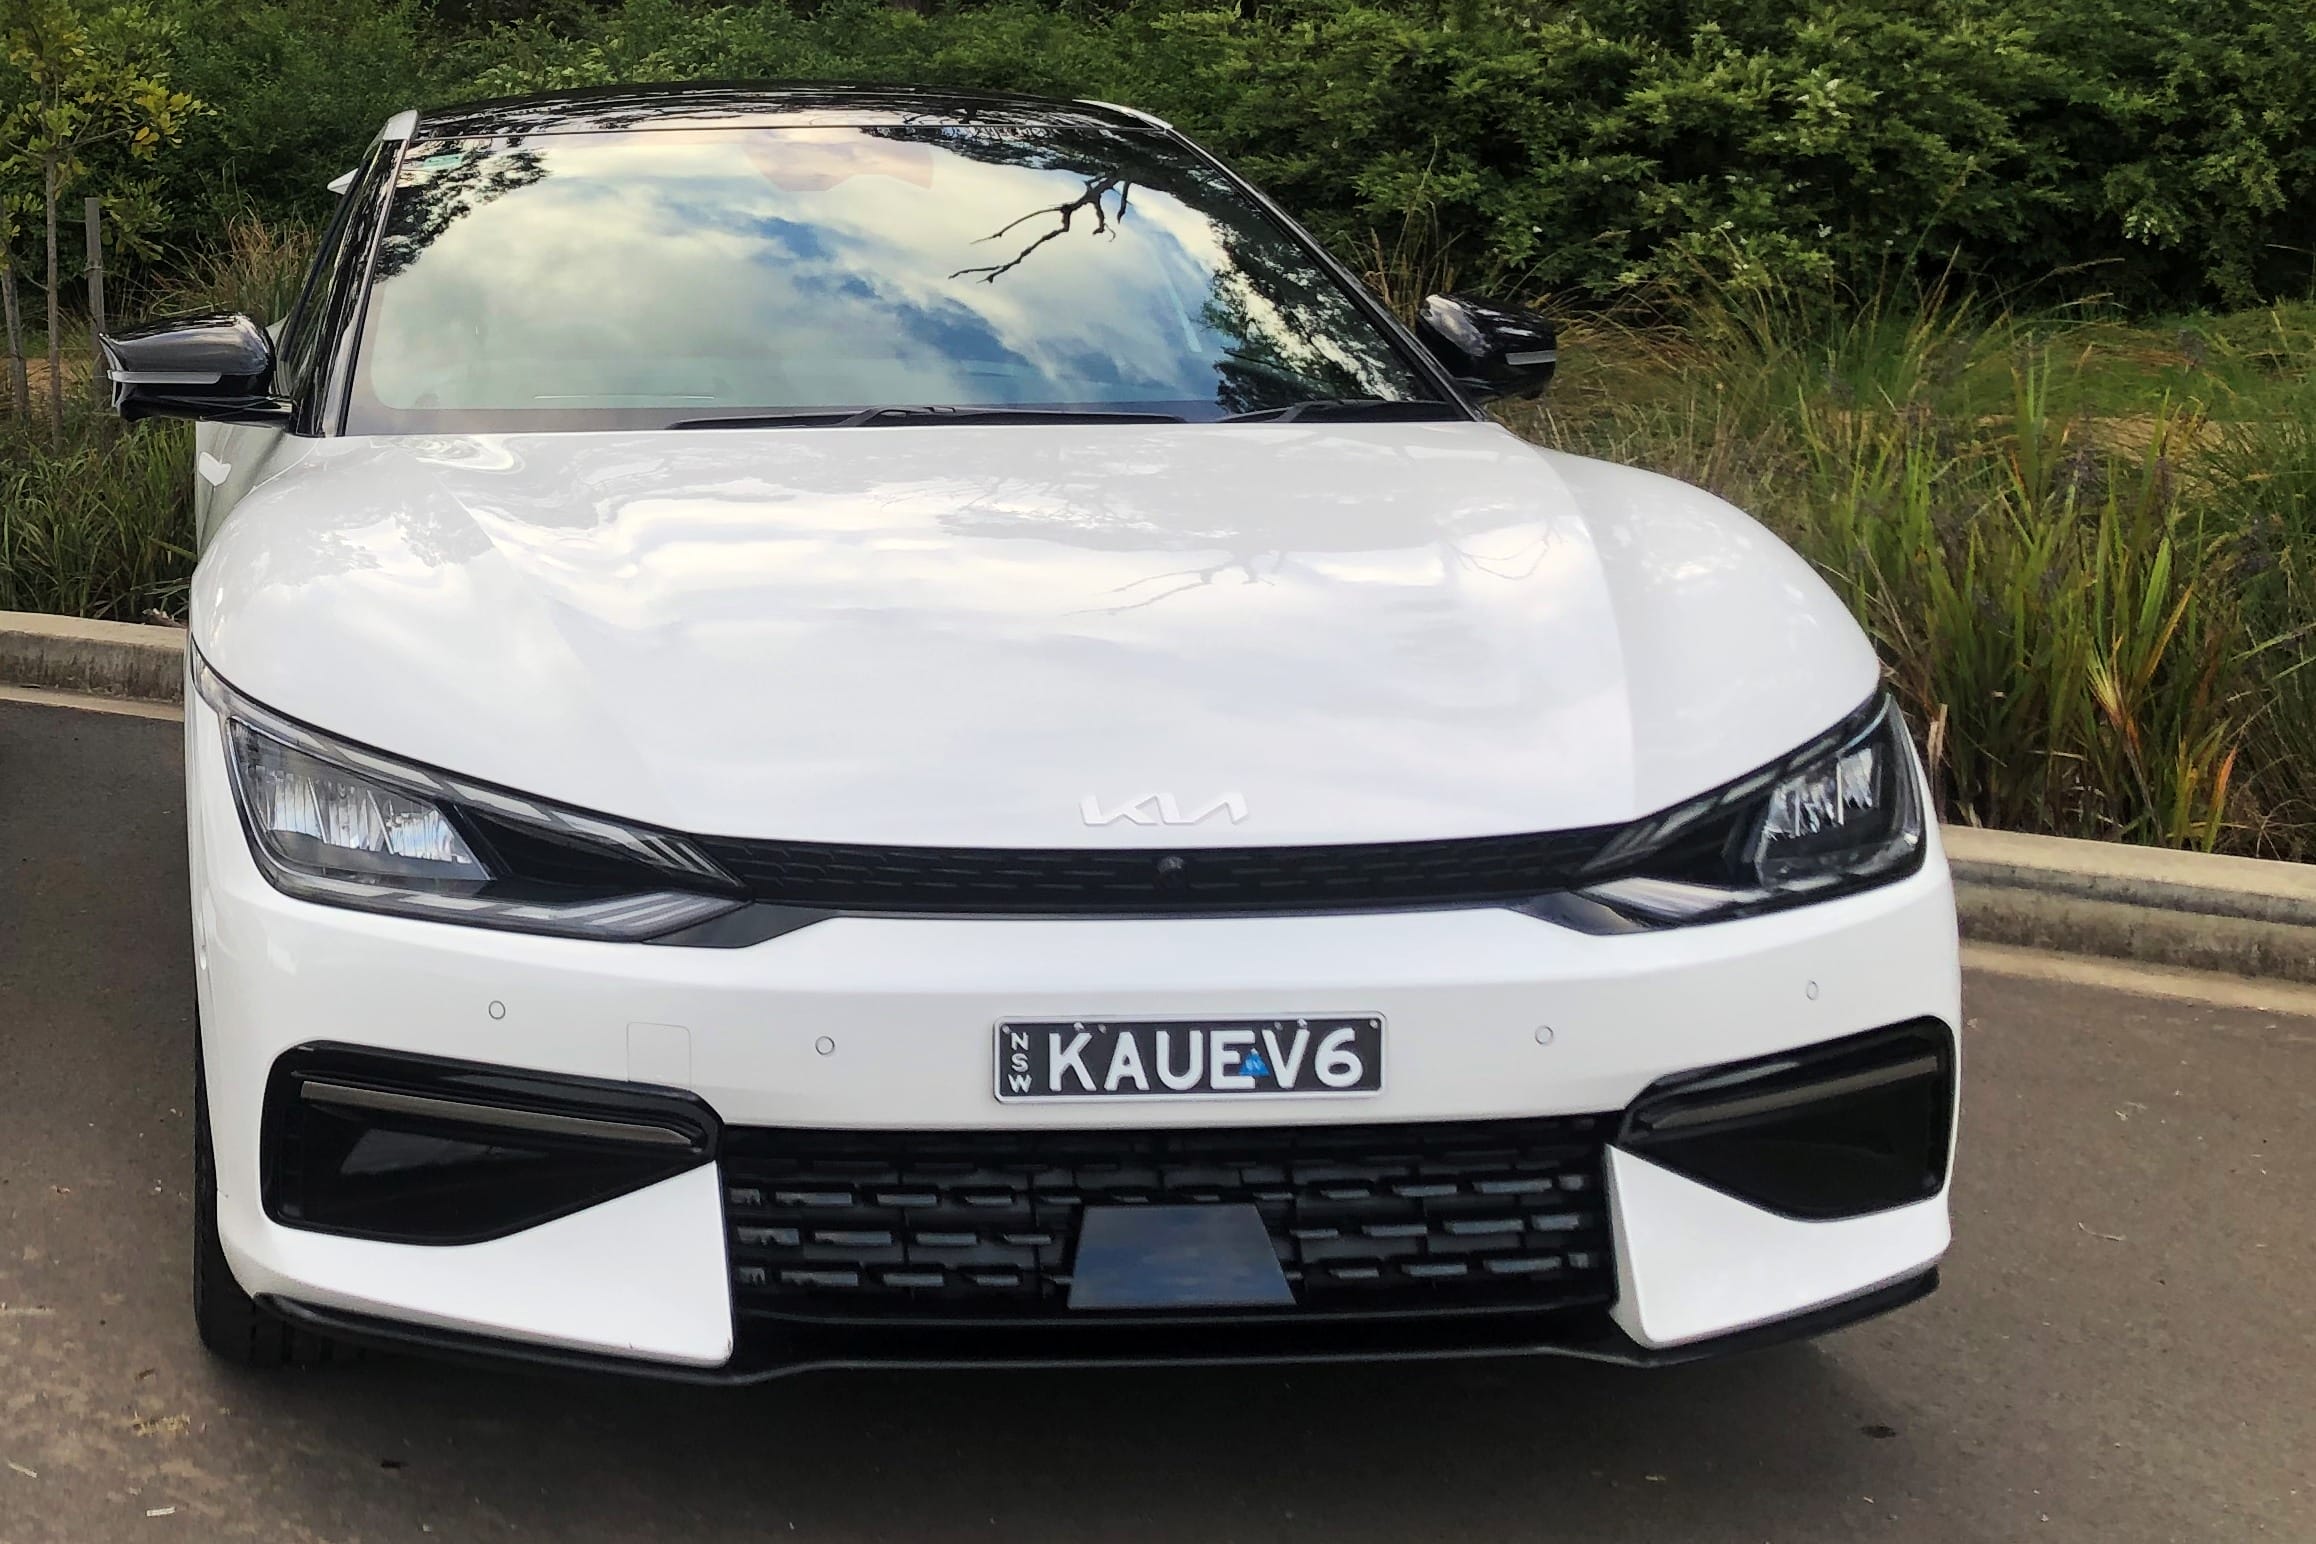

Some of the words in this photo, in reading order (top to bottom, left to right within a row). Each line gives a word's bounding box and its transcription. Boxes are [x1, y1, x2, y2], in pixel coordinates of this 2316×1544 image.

[1081, 793, 1249, 825] KIA
[1008, 1032, 1032, 1093] NSW
[1048, 1028, 1363, 1091] KAUEV6
